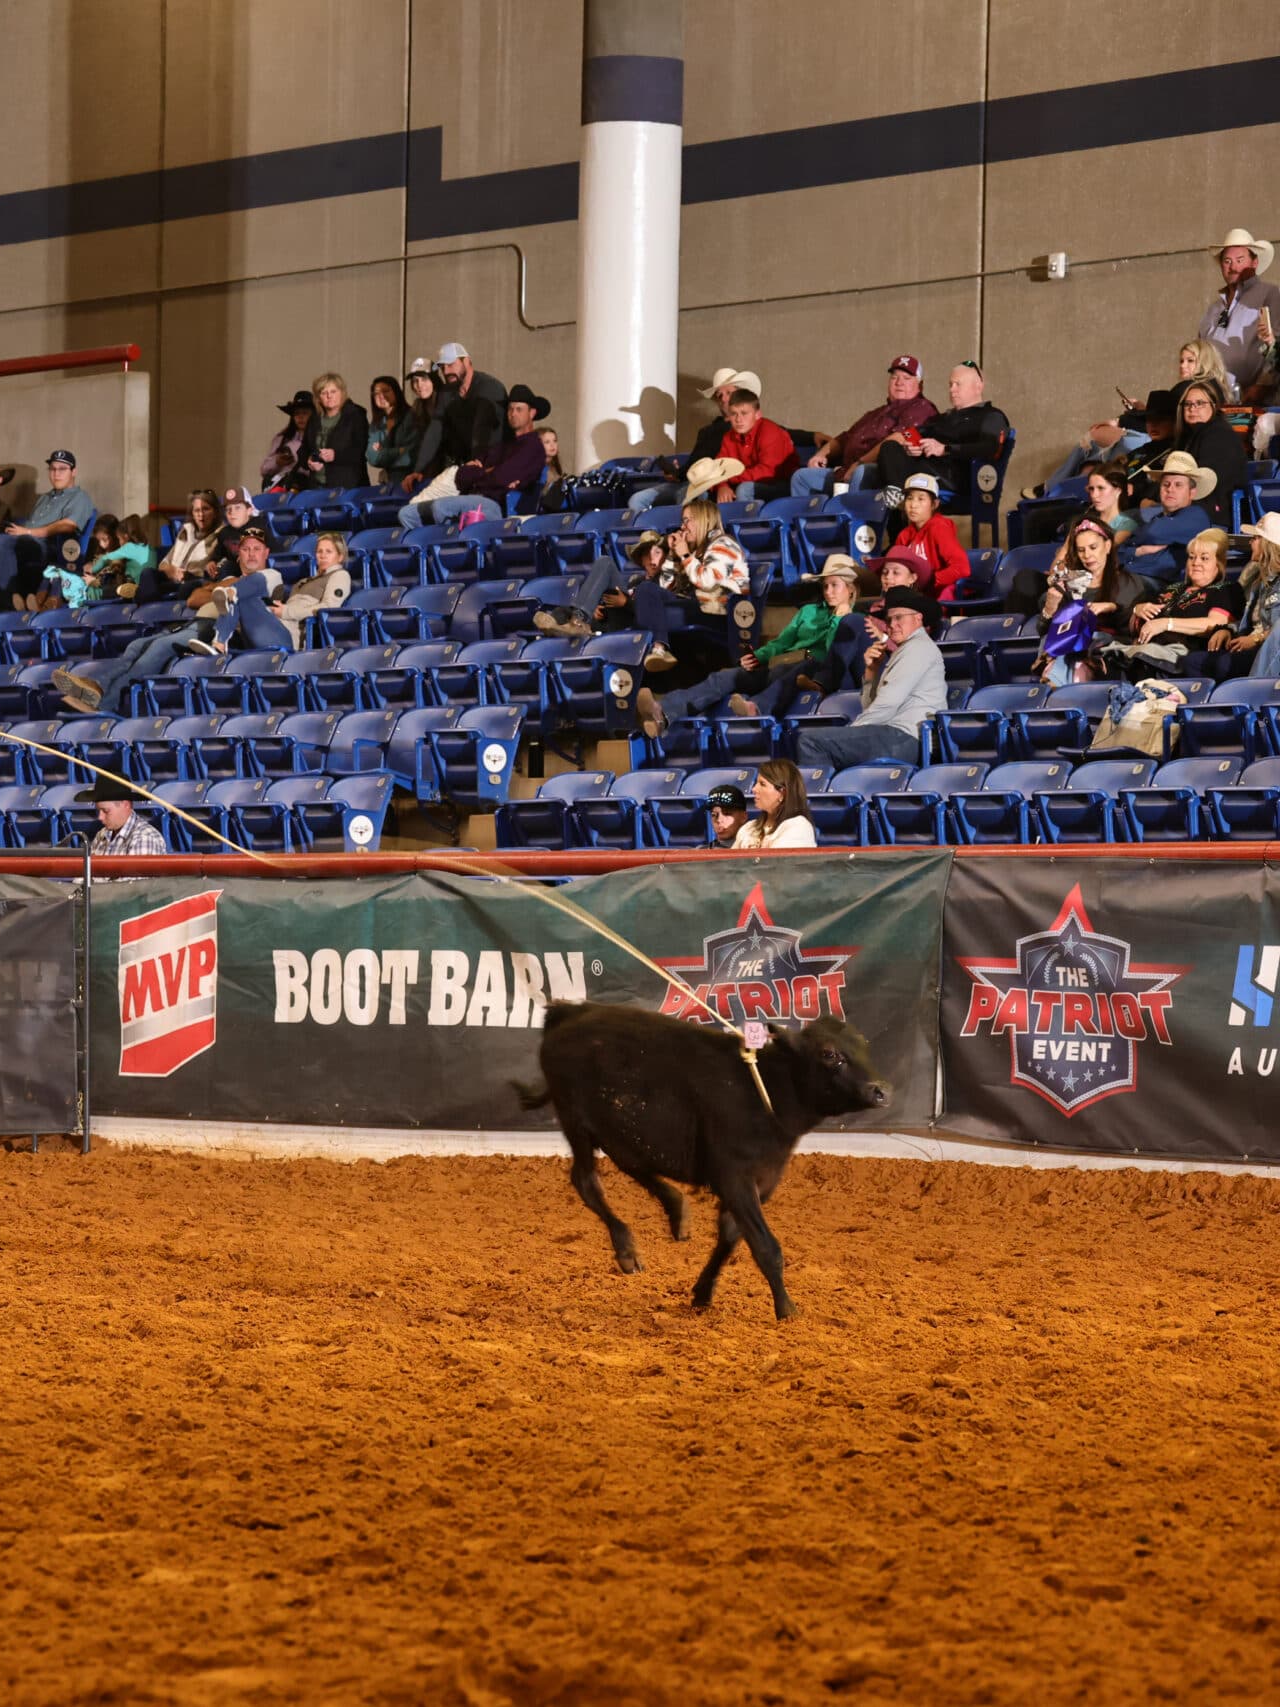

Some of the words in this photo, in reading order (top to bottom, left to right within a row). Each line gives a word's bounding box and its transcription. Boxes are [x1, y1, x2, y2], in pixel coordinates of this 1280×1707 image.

[122, 938, 217, 1024] MVP
[273, 948, 420, 1026] BOOT
[736, 959, 764, 977] THE
[1056, 966, 1090, 988] THE
[658, 971, 847, 1026] PATRIOT
[960, 982, 1173, 1046] PATRIOT
[1032, 1040, 1111, 1063] EVENT
